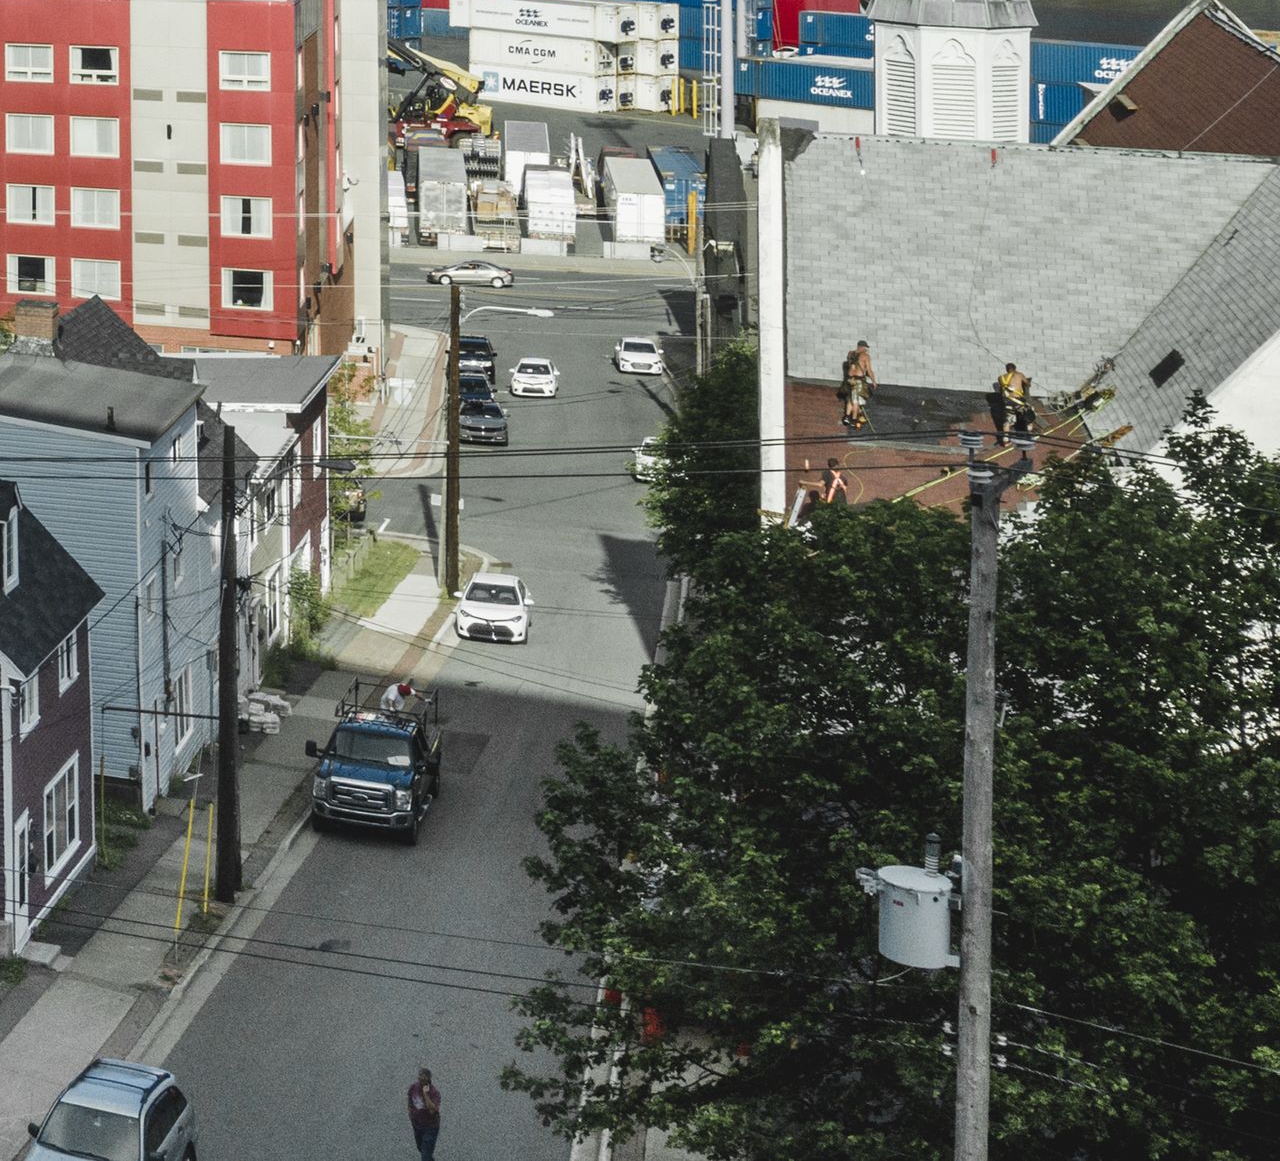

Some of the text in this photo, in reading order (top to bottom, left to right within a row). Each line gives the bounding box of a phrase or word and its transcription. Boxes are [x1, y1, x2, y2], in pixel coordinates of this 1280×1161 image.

[515, 18, 548, 28] OCEANEX
[508, 45, 556, 58] CMA CGM
[1094, 69, 1122, 79] OCEA
[502, 77, 577, 98] MAERSK
[810, 87, 853, 98] OCEANEX
